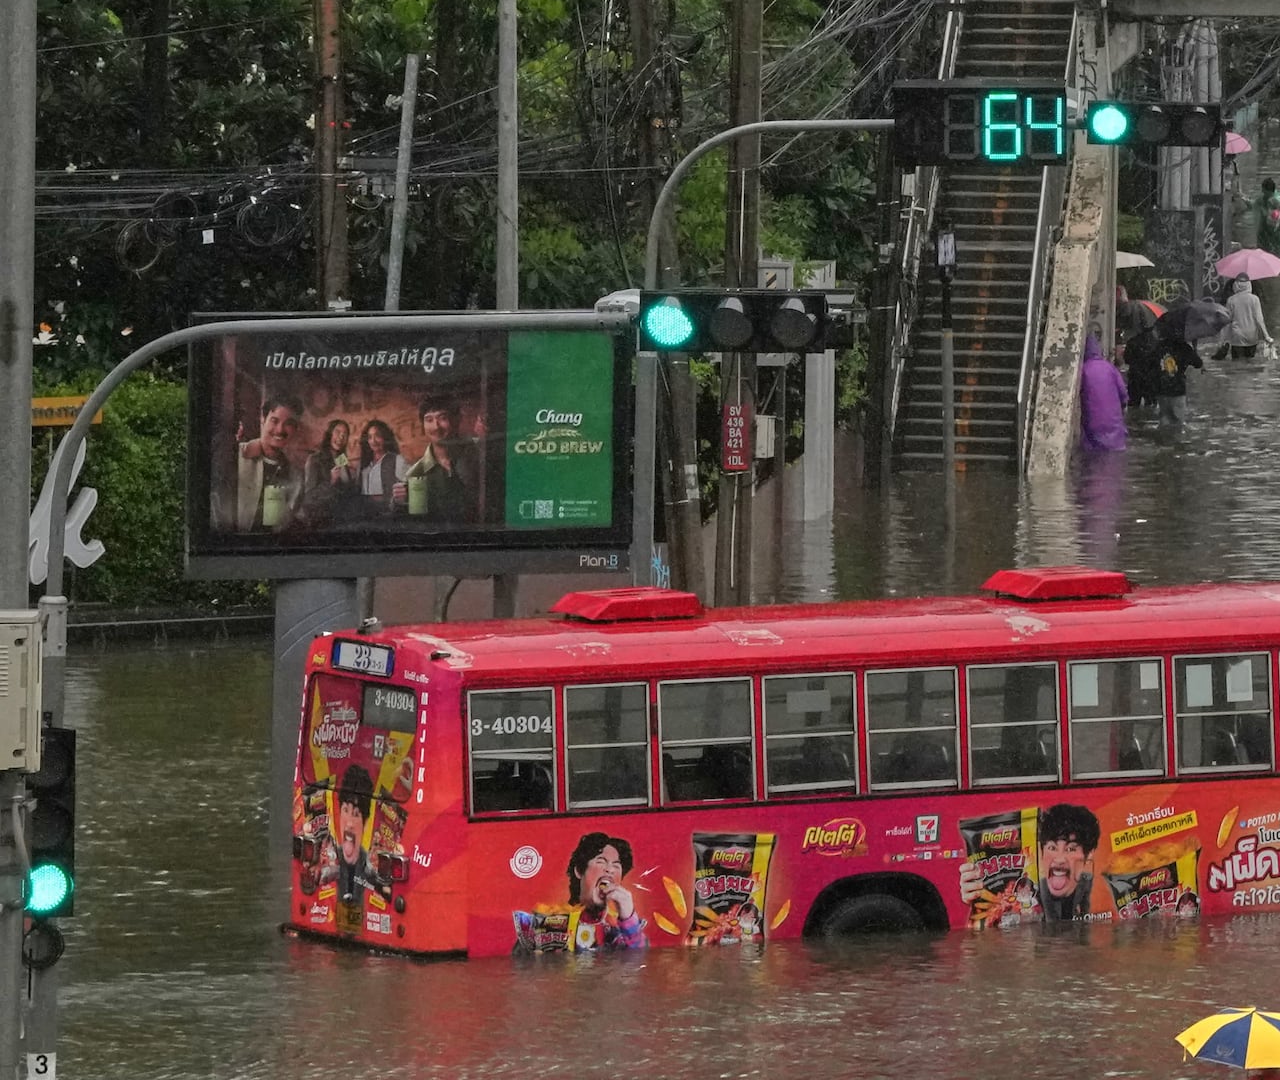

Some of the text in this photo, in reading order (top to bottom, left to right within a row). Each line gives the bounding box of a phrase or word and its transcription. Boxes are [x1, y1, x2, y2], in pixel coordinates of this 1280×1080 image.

[985, 93, 1062, 160] 64
[535, 409, 583, 427] Chang
[729, 406, 742, 416] SV
[727, 417, 744, 427] 436
[729, 428, 742, 438] BA
[514, 440, 603, 455] COLD BREW
[727, 438, 744, 448] 421
[375, 689, 415, 713] 3-40304
[471, 715, 553, 737] 3-40304
[1247, 813, 1277, 828] POTATO
[35, 1055, 49, 1074] 3
